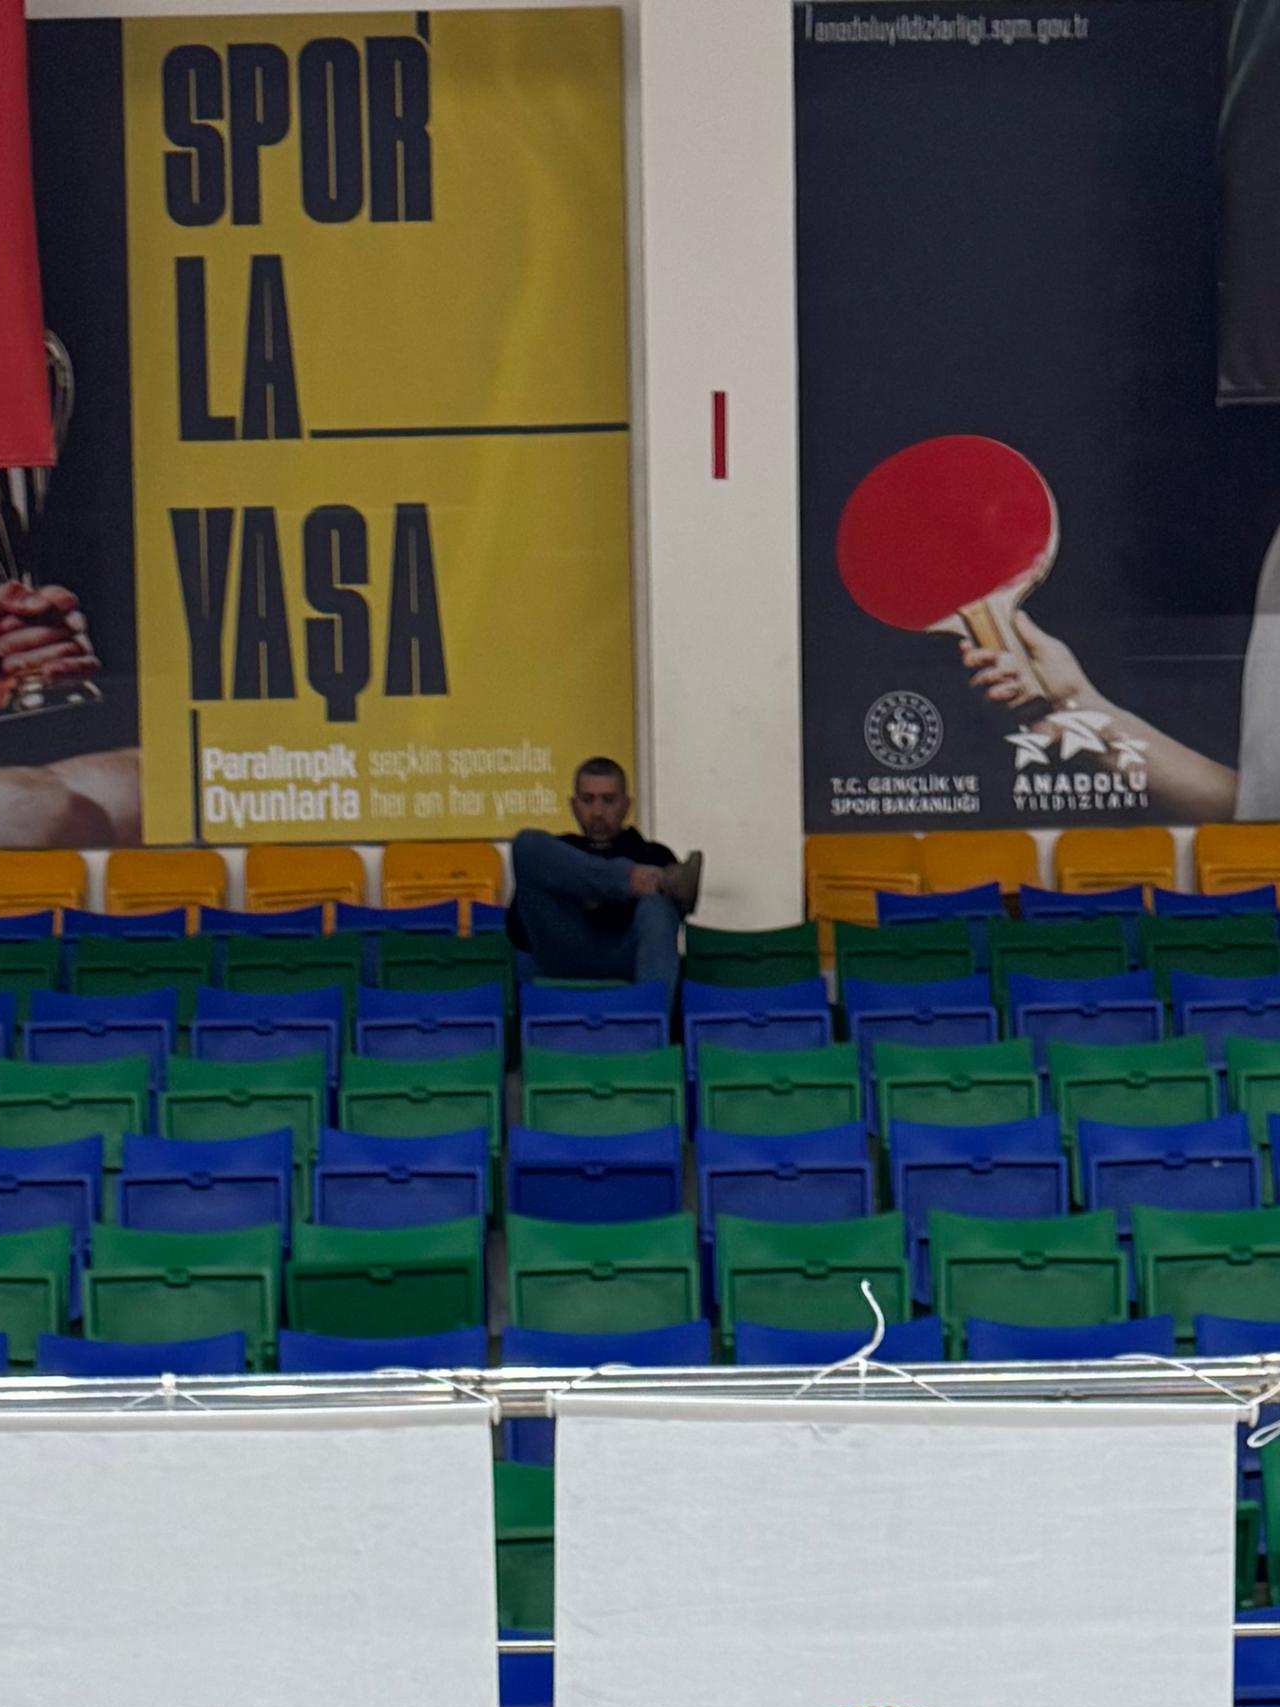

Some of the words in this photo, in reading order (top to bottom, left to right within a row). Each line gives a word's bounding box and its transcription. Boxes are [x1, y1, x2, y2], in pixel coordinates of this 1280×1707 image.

[161, 37, 434, 227] SPOR
[174, 253, 303, 442] LA
[167, 502, 450, 723] YAŞA
[203, 743, 358, 784] Paralimpik
[205, 781, 361, 829] Oyunlarla
[1013, 770, 1148, 794] ANADOLU
